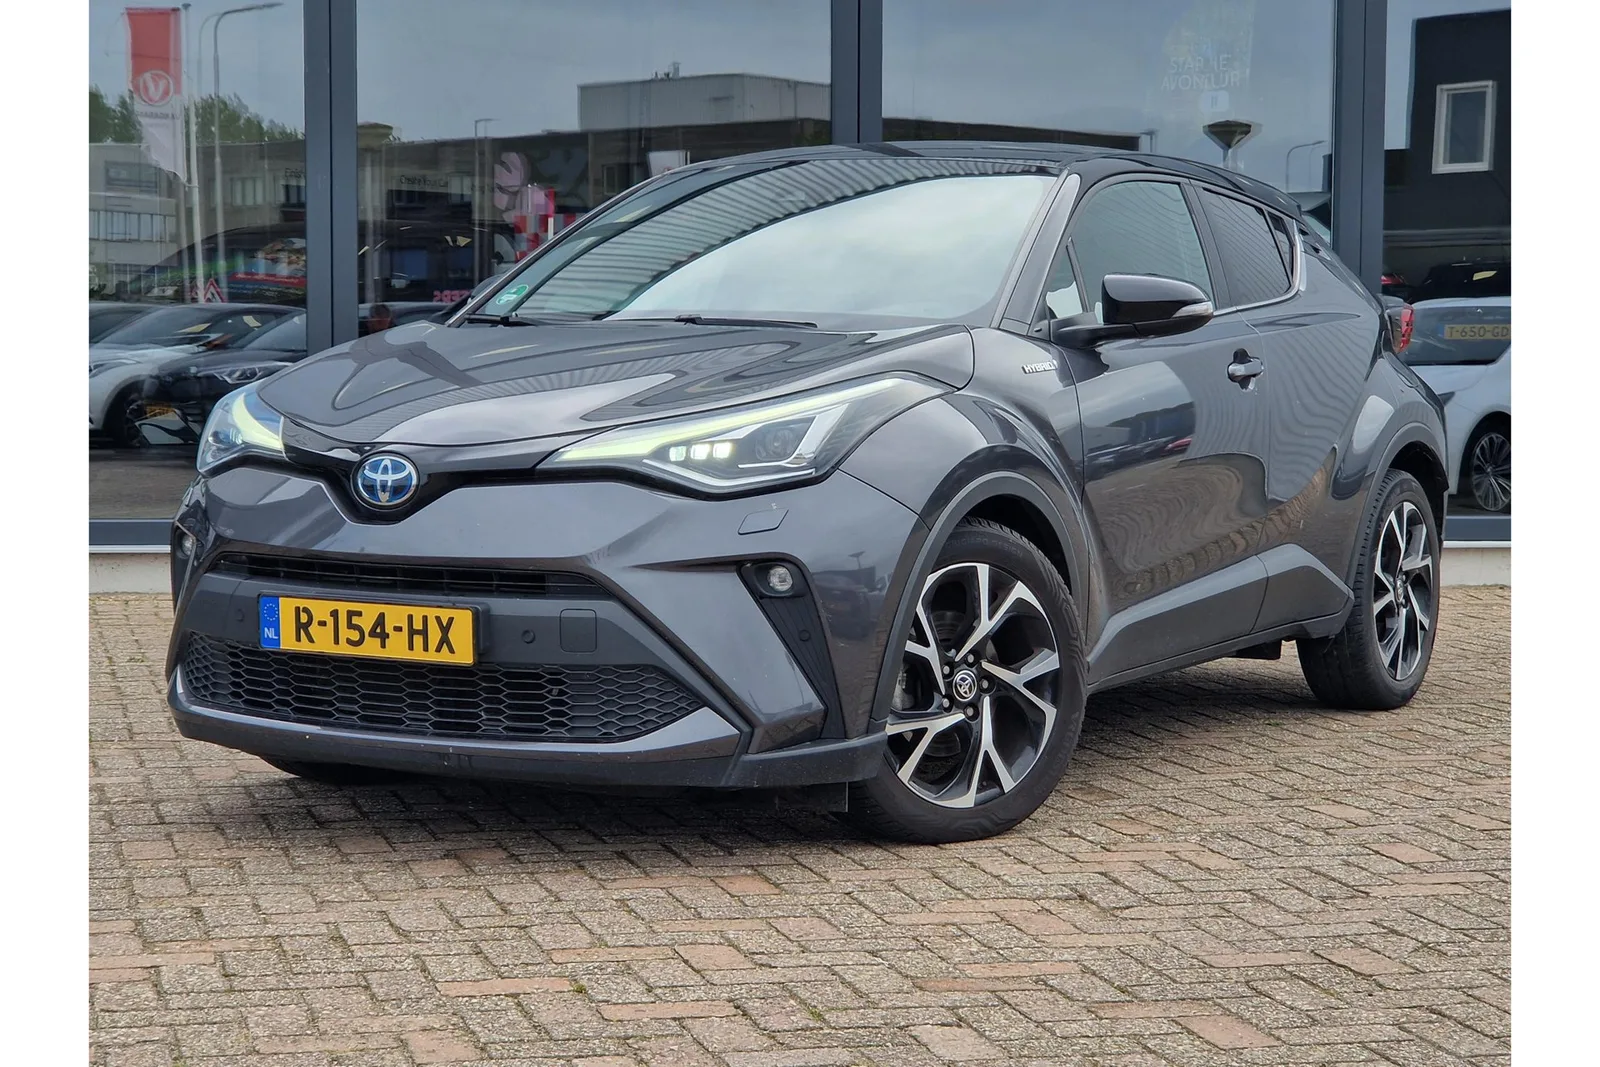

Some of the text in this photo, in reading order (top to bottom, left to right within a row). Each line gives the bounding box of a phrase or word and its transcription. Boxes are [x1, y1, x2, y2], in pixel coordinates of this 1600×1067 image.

[1447, 326, 1509, 338] T-650-GD
[1021, 361, 1055, 374] HYBRID
[264, 627, 279, 639] NL
[294, 606, 456, 654] R-154-HX
